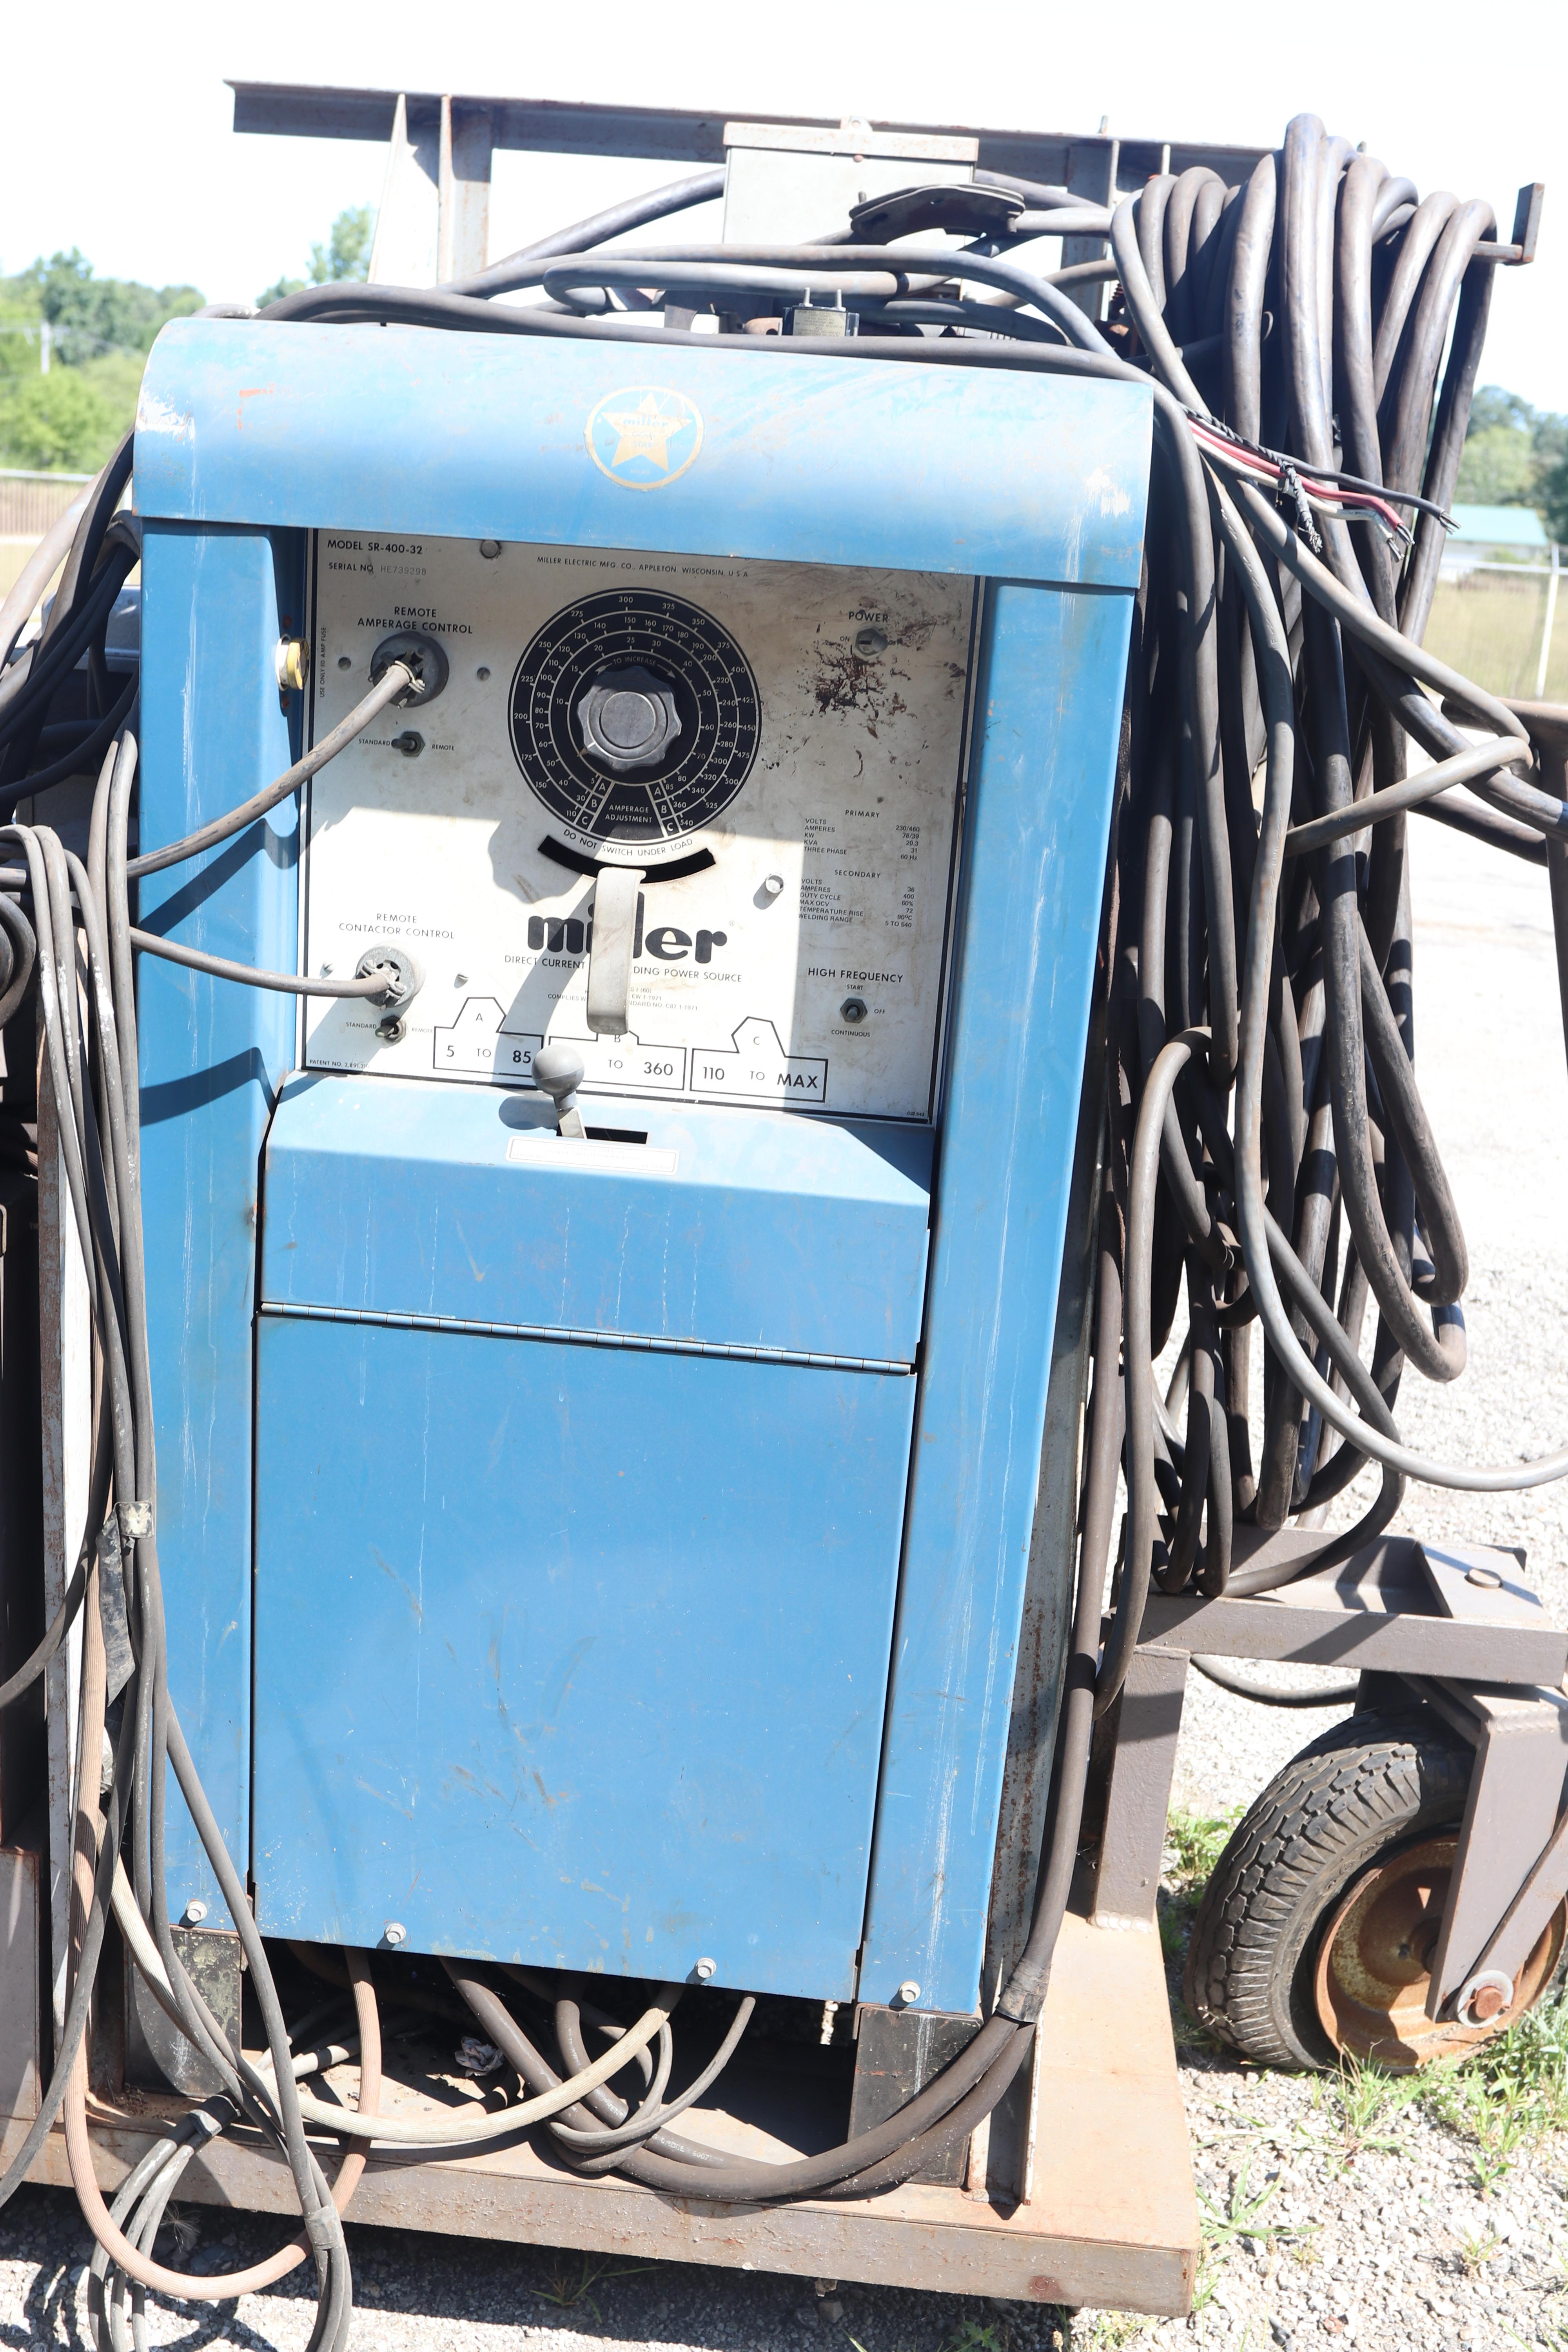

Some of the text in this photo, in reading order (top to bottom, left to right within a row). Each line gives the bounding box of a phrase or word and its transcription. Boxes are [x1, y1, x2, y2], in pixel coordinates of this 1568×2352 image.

[327, 539, 423, 555] MODEL SR-400-32
[329, 562, 356, 572] SERIAL
[380, 566, 426, 575] HE739298
[639, 564, 678, 573] APPLETON,
[682, 567, 725, 576] WISCONSIN,
[394, 606, 437, 618] REMOTE
[849, 611, 888, 622] POWER
[358, 618, 472, 634] AMPERAGE CONTROL
[625, 657, 656, 666] INCREASE
[599, 782, 606, 791] A
[654, 787, 661, 795] A
[591, 799, 597, 808] B
[609, 804, 649, 813] AMPERAGE
[661, 805, 667, 813] B
[605, 814, 652, 823] ADJUSTMENT
[845, 810, 880, 818] PRIMARY
[581, 817, 588, 825] C
[667, 822, 673, 831] C
[563, 829, 693, 856] DO NOT SWITCH UNDER LOAD
[834, 869, 881, 878] SECONDARY
[799, 907, 847, 915] TEMPERATURE
[377, 913, 417, 923] REMOTE
[339, 923, 455, 939] CONTACTOR CONTROL
[505, 955, 742, 982] DIRECT CURRENT POWER SOURCE
[808, 968, 903, 983] HIGH FREQUENCY
[475, 1013, 483, 1022] A
[753, 1037, 760, 1045] C
[446, 1045, 531, 1063] 5 TO 85
[608, 1060, 673, 1075] TO 360
[703, 1067, 818, 1089] 110 TO MAX
[692, 2151, 710, 2160] 6007
